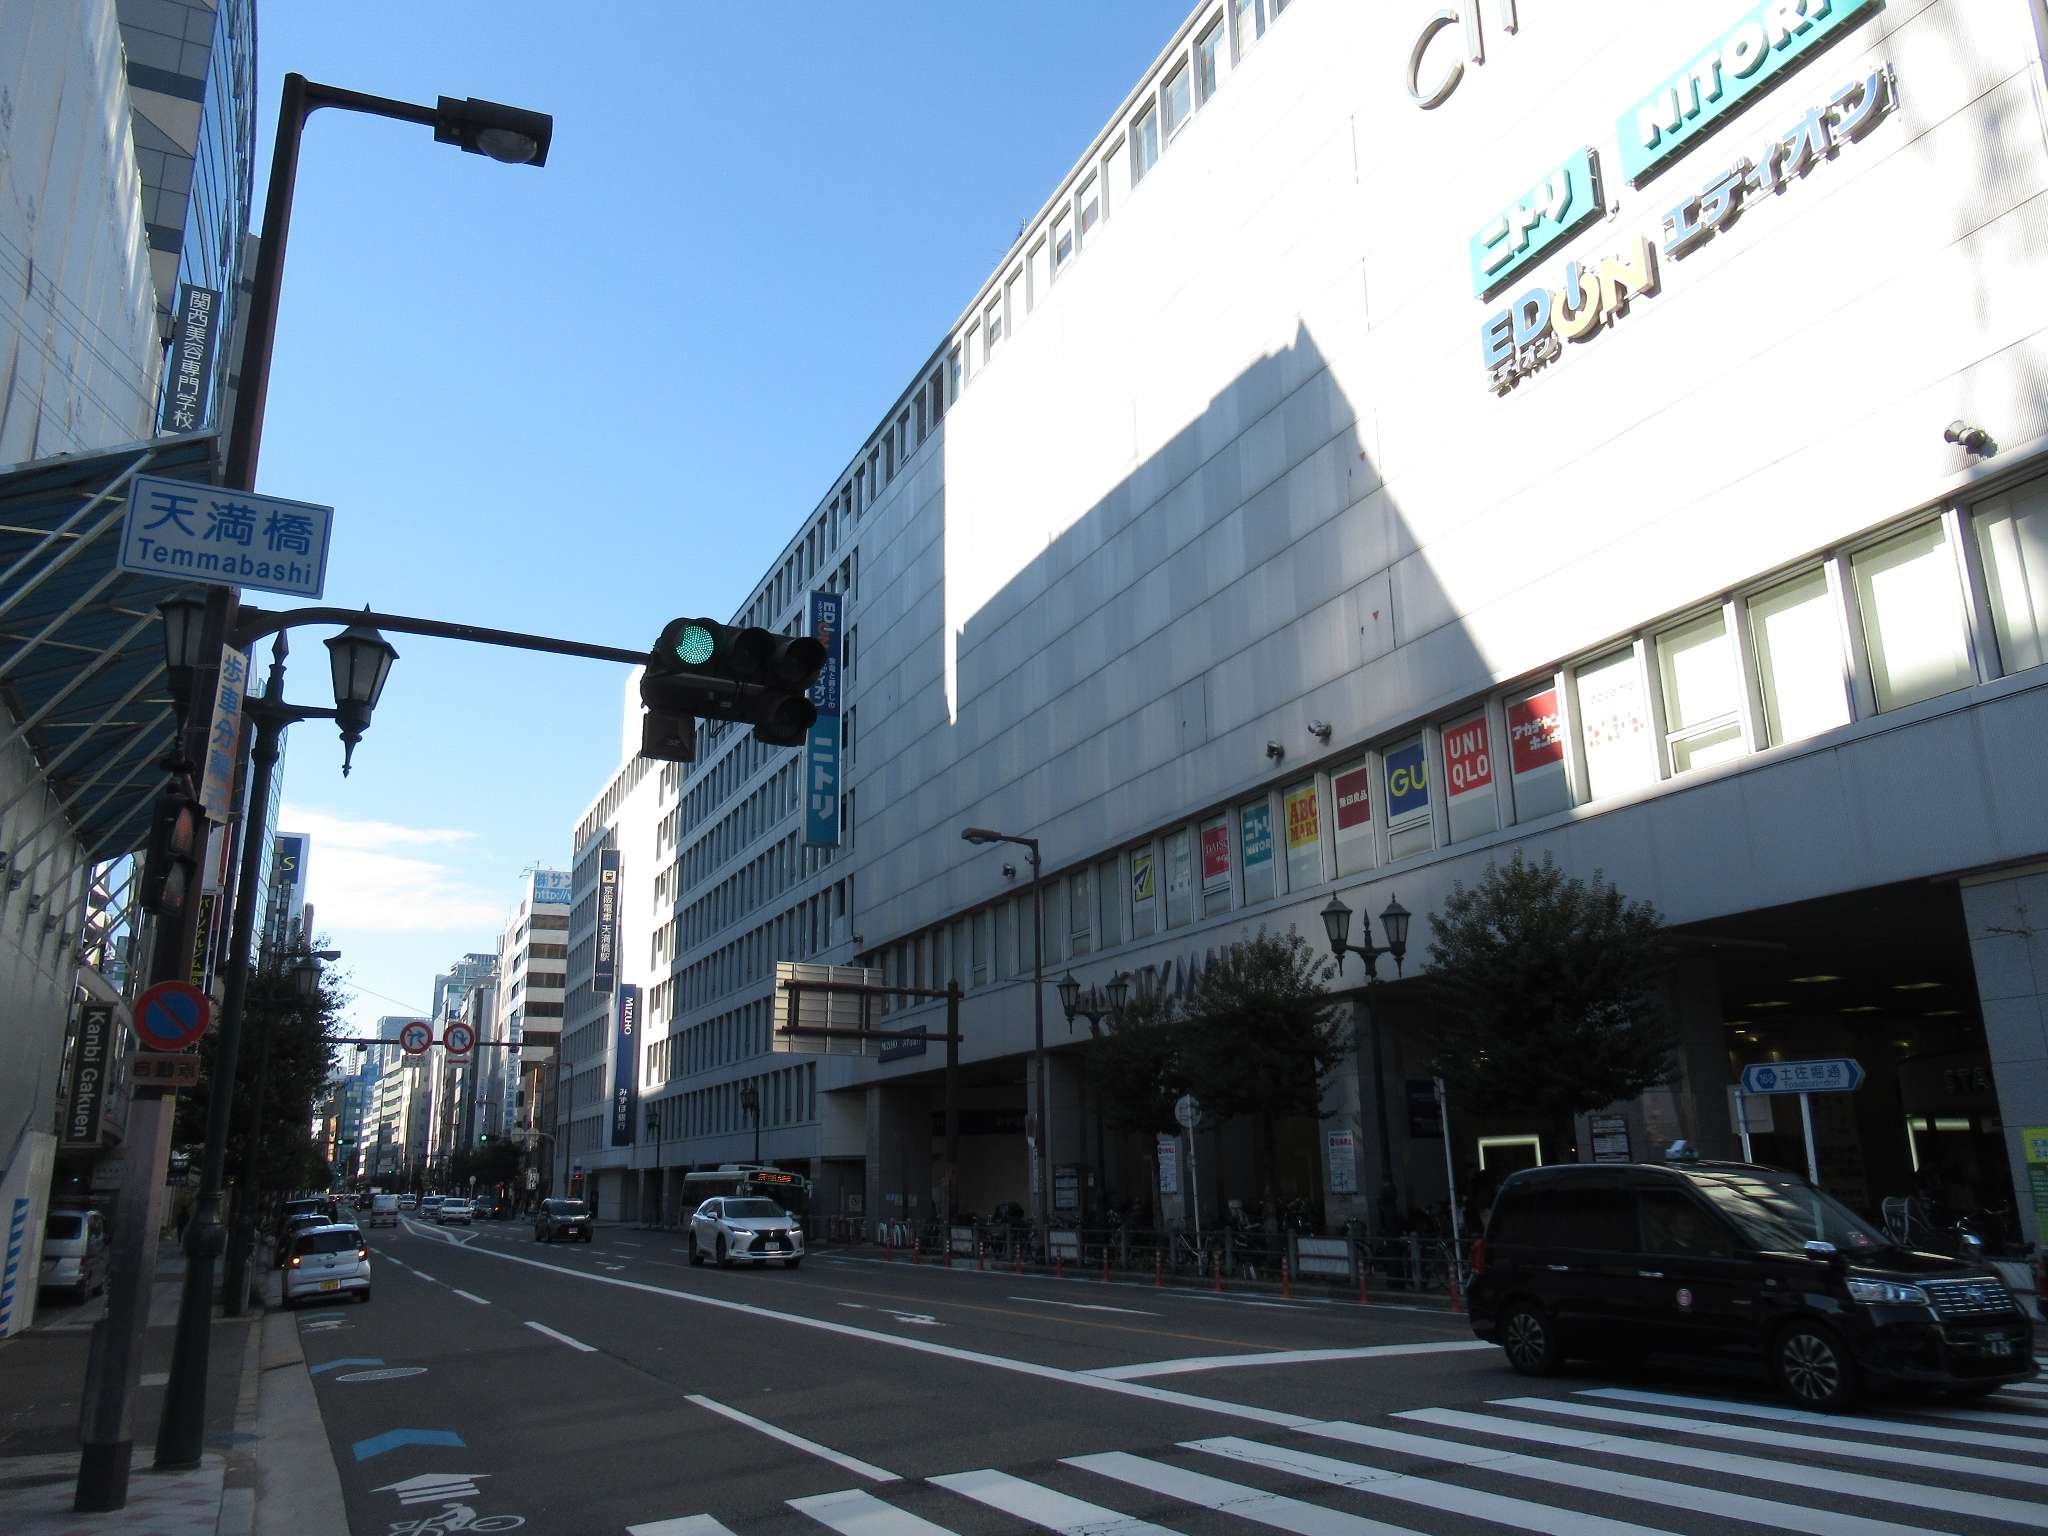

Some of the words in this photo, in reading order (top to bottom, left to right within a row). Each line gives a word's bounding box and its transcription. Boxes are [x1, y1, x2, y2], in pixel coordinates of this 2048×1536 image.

[1661, 64, 1890, 259] エディオン
[1479, 166, 1574, 277] ニトリ
[1480, 232, 1658, 370] EDION
[172, 289, 212, 430] 関西美容専門学校
[1487, 334, 1564, 397] エディオン
[143, 490, 315, 557] 天満橋
[137, 536, 313, 586] Temmabashi
[1449, 727, 1483, 759] UNI
[812, 736, 834, 821] ニトリ
[1390, 760, 1428, 797] GU
[1452, 754, 1489, 788] QLO
[1246, 838, 1272, 856] NITOR
[602, 886, 614, 922] 京阪電車
[600, 925, 613, 962] 天満橋駅
[82, 1011, 107, 1063] Kanbi
[623, 995, 634, 1036] MIZUHO
[1780, 1063, 1841, 1081] 土佐堀通
[72, 1067, 99, 1138] Gakuen
[617, 1087, 628, 1131] みずほ銀行
